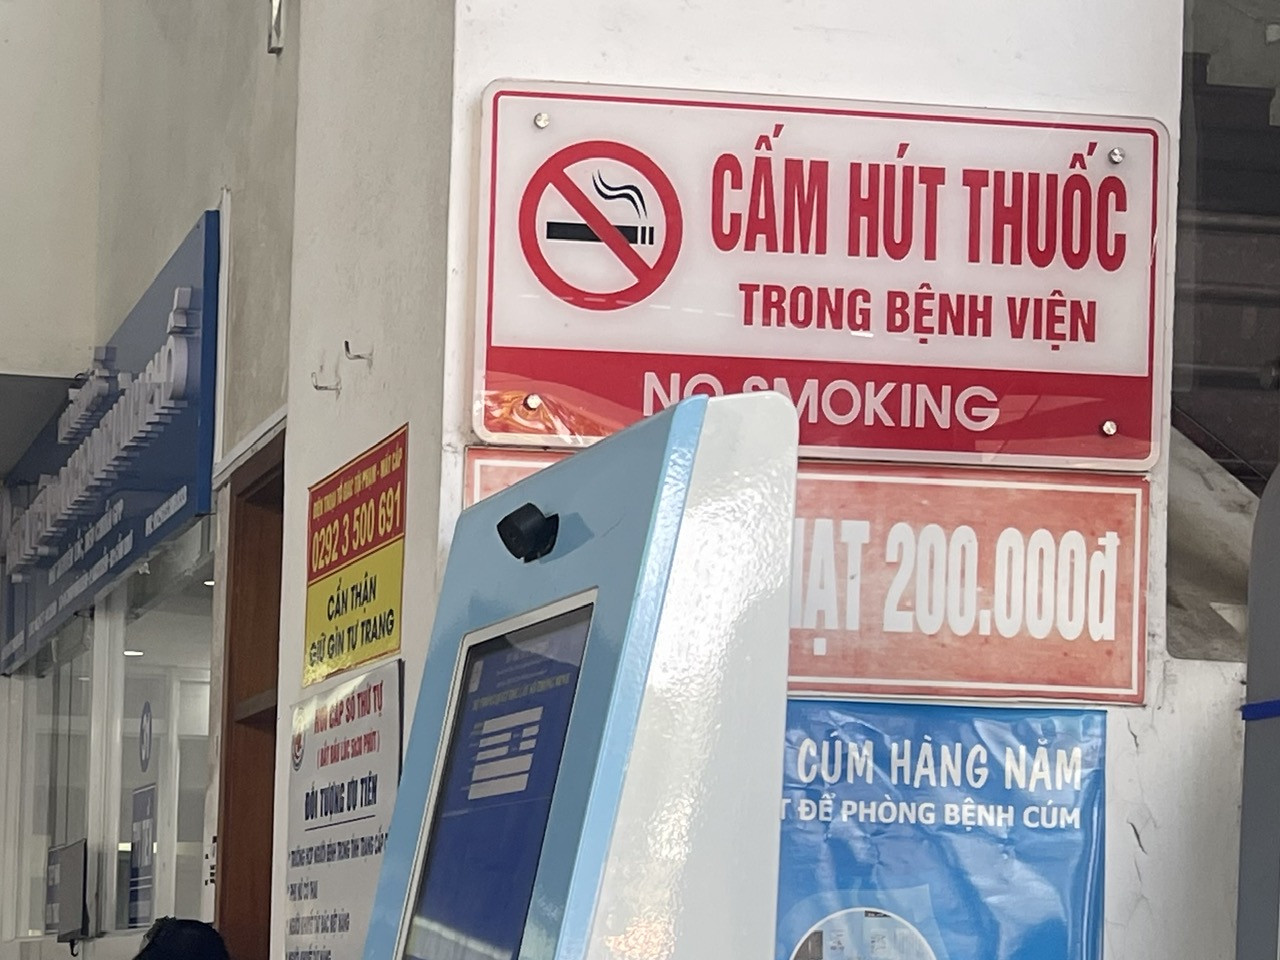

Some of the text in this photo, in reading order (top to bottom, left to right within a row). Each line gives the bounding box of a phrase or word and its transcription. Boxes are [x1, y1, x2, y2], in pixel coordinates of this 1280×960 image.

[711, 124, 1127, 273] CẤM HÚT THUỐC
[739, 283, 1096, 351] TRONG BỆNH VIỆN
[312, 519, 340, 572] 0292
[342, 512, 350, 557] 3
[352, 499, 375, 551] 500
[378, 481, 401, 538] 691
[327, 571, 377, 621] CẨN THẬN
[790, 518, 1120, 656] ẠT 200.000đ
[361, 609, 394, 645] TRANG
[797, 731, 1082, 793] CÚM HÀNG NĂM
[798, 793, 837, 822] ĐỂ
[841, 794, 936, 825] PHÒNG
[944, 797, 1014, 831] BỆNH
[1023, 800, 1081, 829] CÚM
